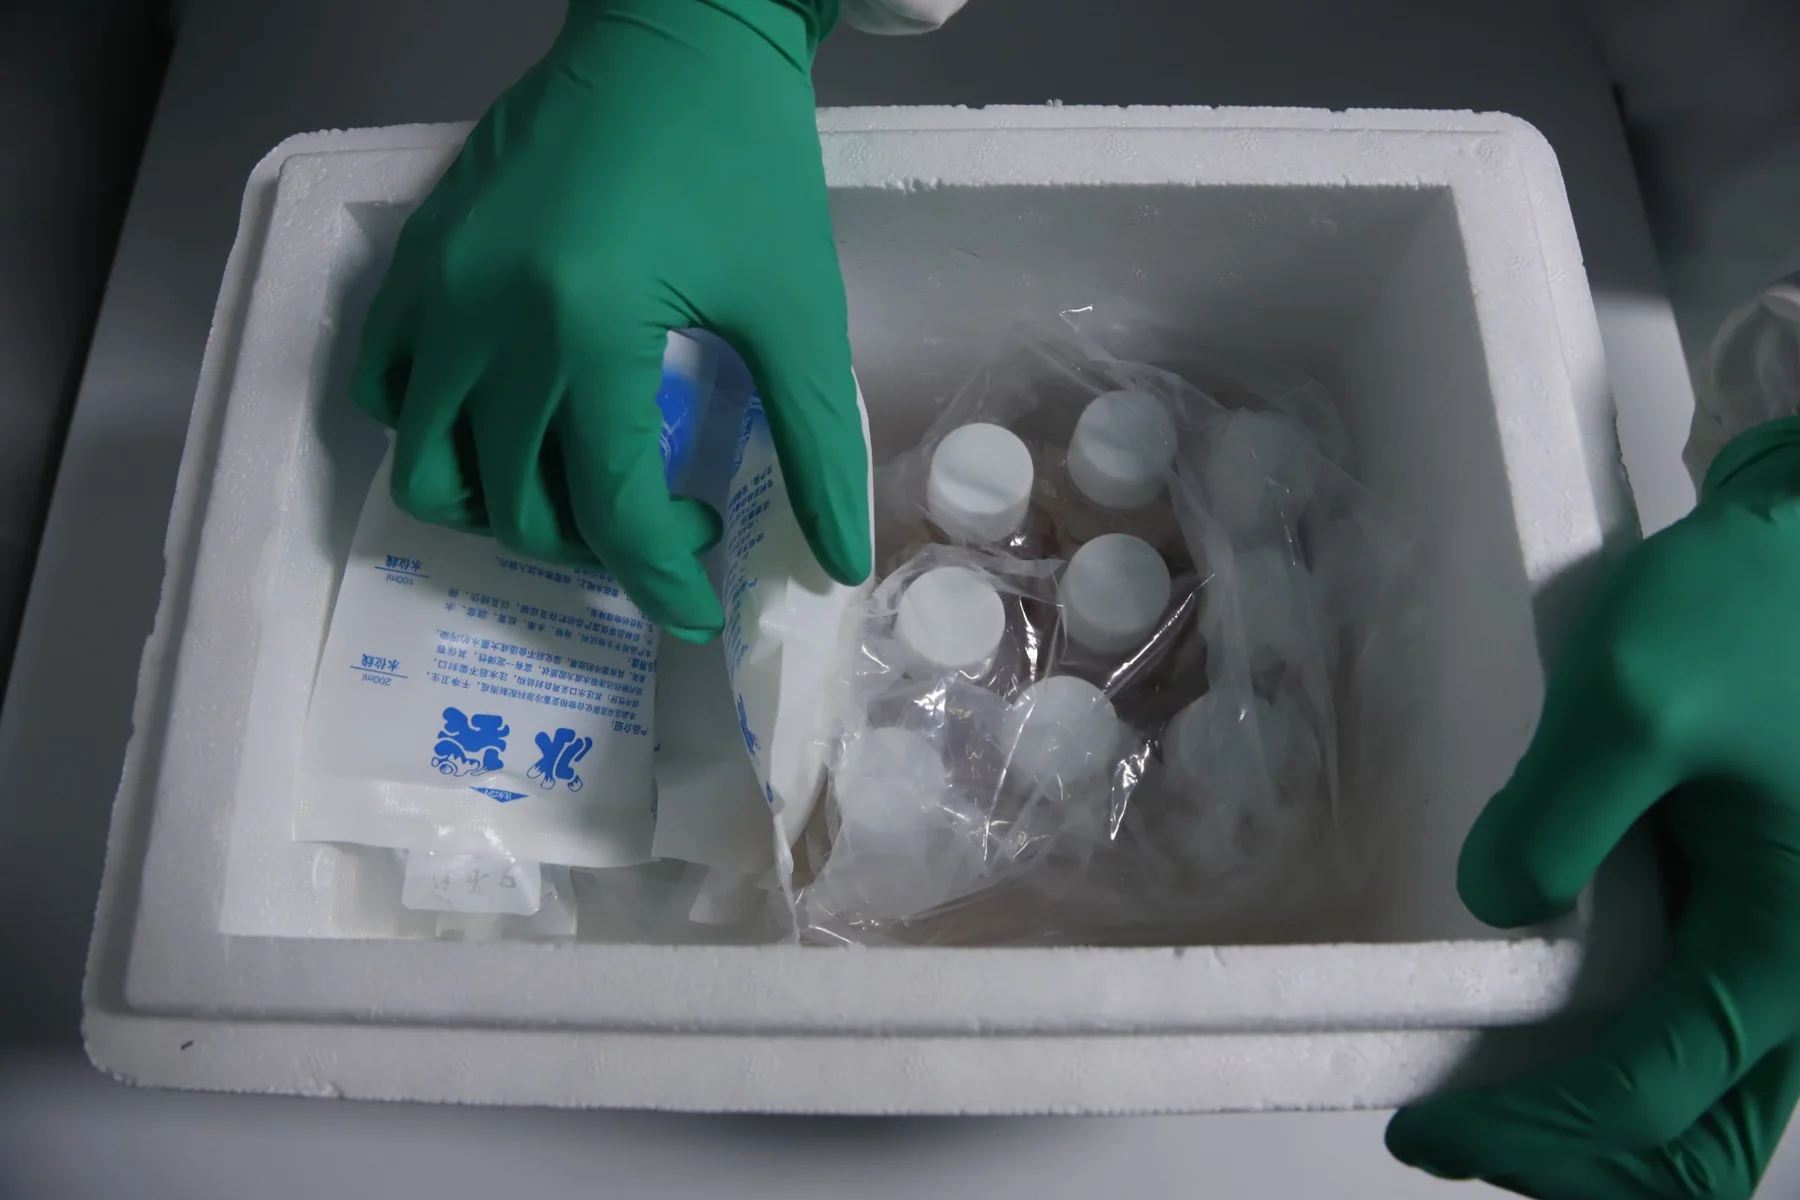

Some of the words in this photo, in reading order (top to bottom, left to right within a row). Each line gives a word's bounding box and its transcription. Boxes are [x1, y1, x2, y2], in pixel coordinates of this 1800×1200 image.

[385, 554, 422, 573] 水位线
[385, 573, 414, 586] 100ml
[361, 653, 400, 672] 水位线
[628, 656, 656, 673] 品用途：
[361, 673, 393, 687] 200ml
[431, 706, 593, 794] 冰袋
